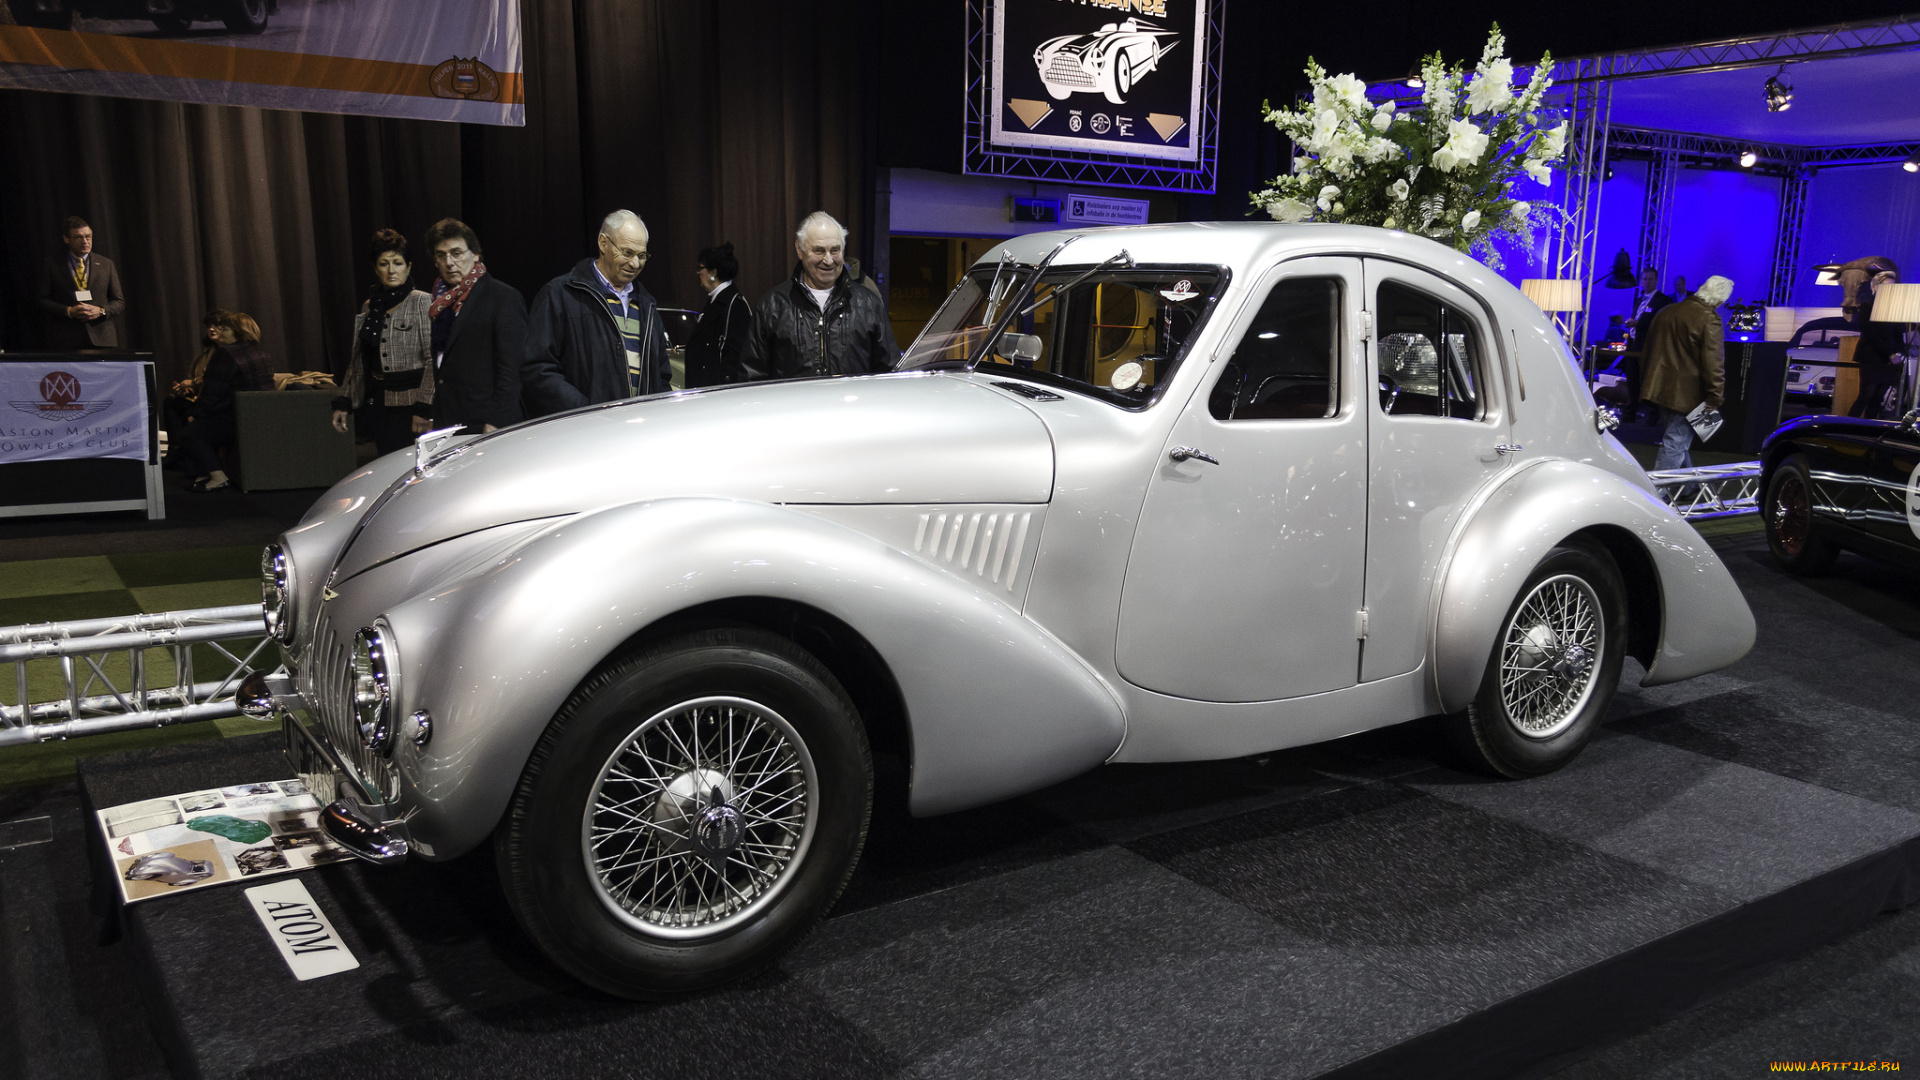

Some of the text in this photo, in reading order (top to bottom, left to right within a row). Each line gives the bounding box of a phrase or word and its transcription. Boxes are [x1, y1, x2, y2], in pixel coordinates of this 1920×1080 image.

[434, 65, 454, 83] TULPEN
[66, 426, 131, 436] MARTIN
[2, 439, 129, 452] OWNERS CLUB
[262, 900, 340, 956] ATOM
